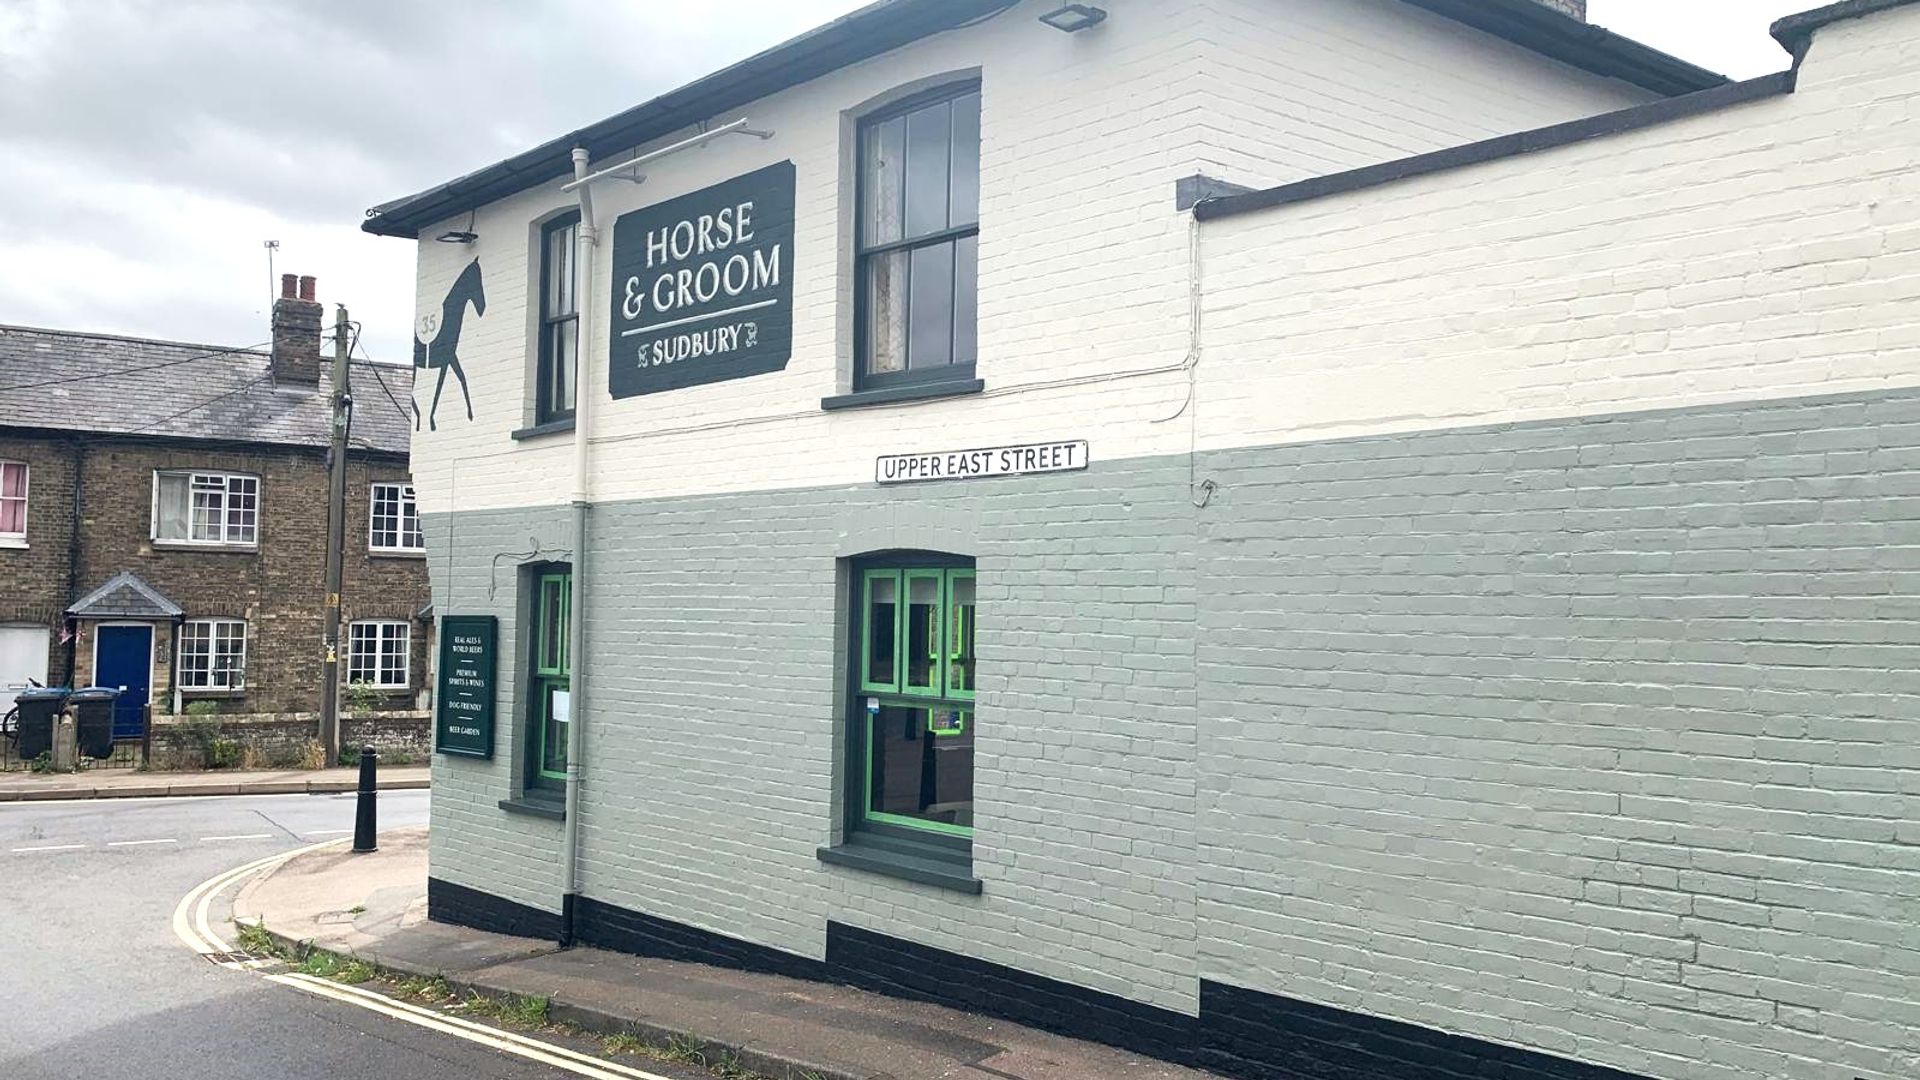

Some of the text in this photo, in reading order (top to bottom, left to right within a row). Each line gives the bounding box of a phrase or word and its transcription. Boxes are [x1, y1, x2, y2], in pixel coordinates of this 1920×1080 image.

[646, 201, 755, 268] HORSE
[622, 244, 780, 320] & GROOM
[421, 313, 436, 335] 35
[652, 323, 743, 366] SUDBURY
[885, 444, 1077, 478] UPPER EAST STREET
[449, 701, 482, 711] DOG FRIENDLY
[461, 726, 480, 736] GARDEN
